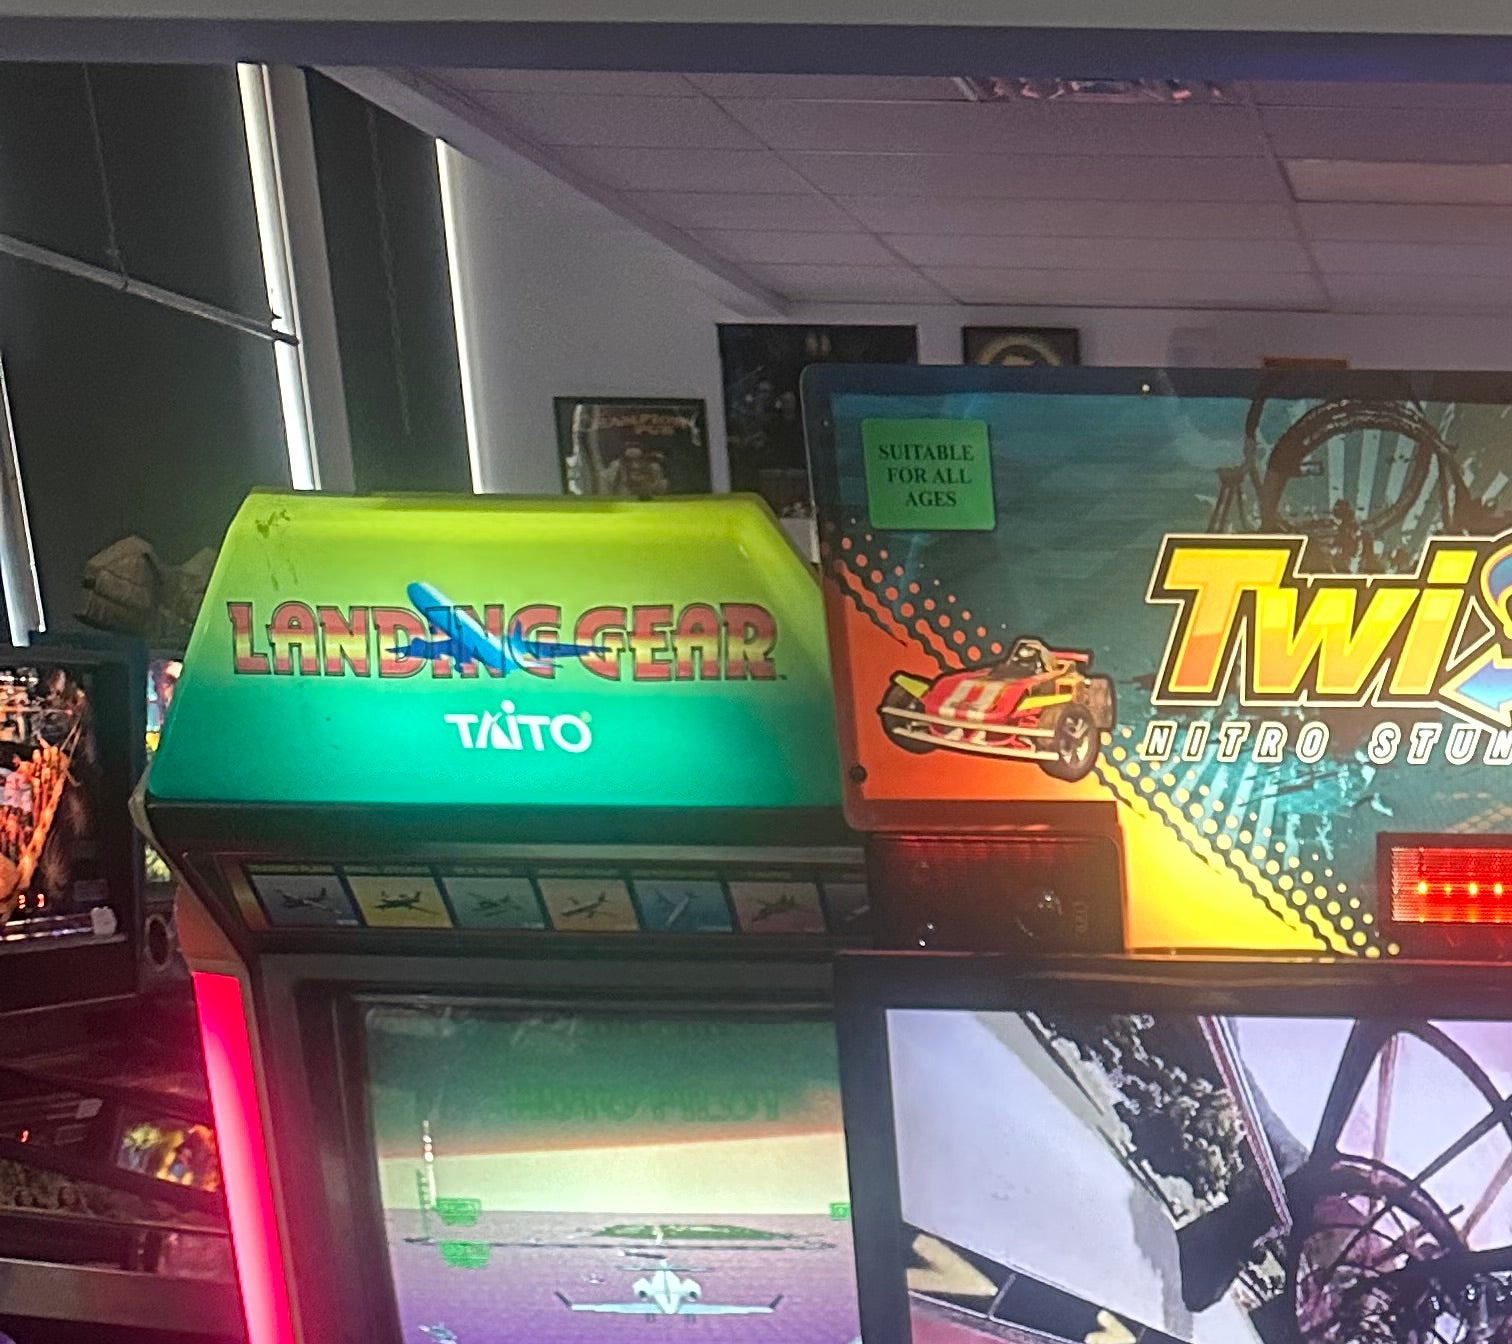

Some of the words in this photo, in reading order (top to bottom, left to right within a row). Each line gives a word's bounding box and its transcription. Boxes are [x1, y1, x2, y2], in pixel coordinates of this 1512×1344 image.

[878, 443, 975, 461] SUITABLE
[887, 467, 927, 484] FOR
[932, 468, 973, 484] ALL
[905, 491, 958, 508] AGES
[227, 601, 562, 680] LANDING
[574, 601, 780, 682] GEAR
[444, 700, 592, 754] TAITO
[1142, 721, 1331, 764] NITRO
